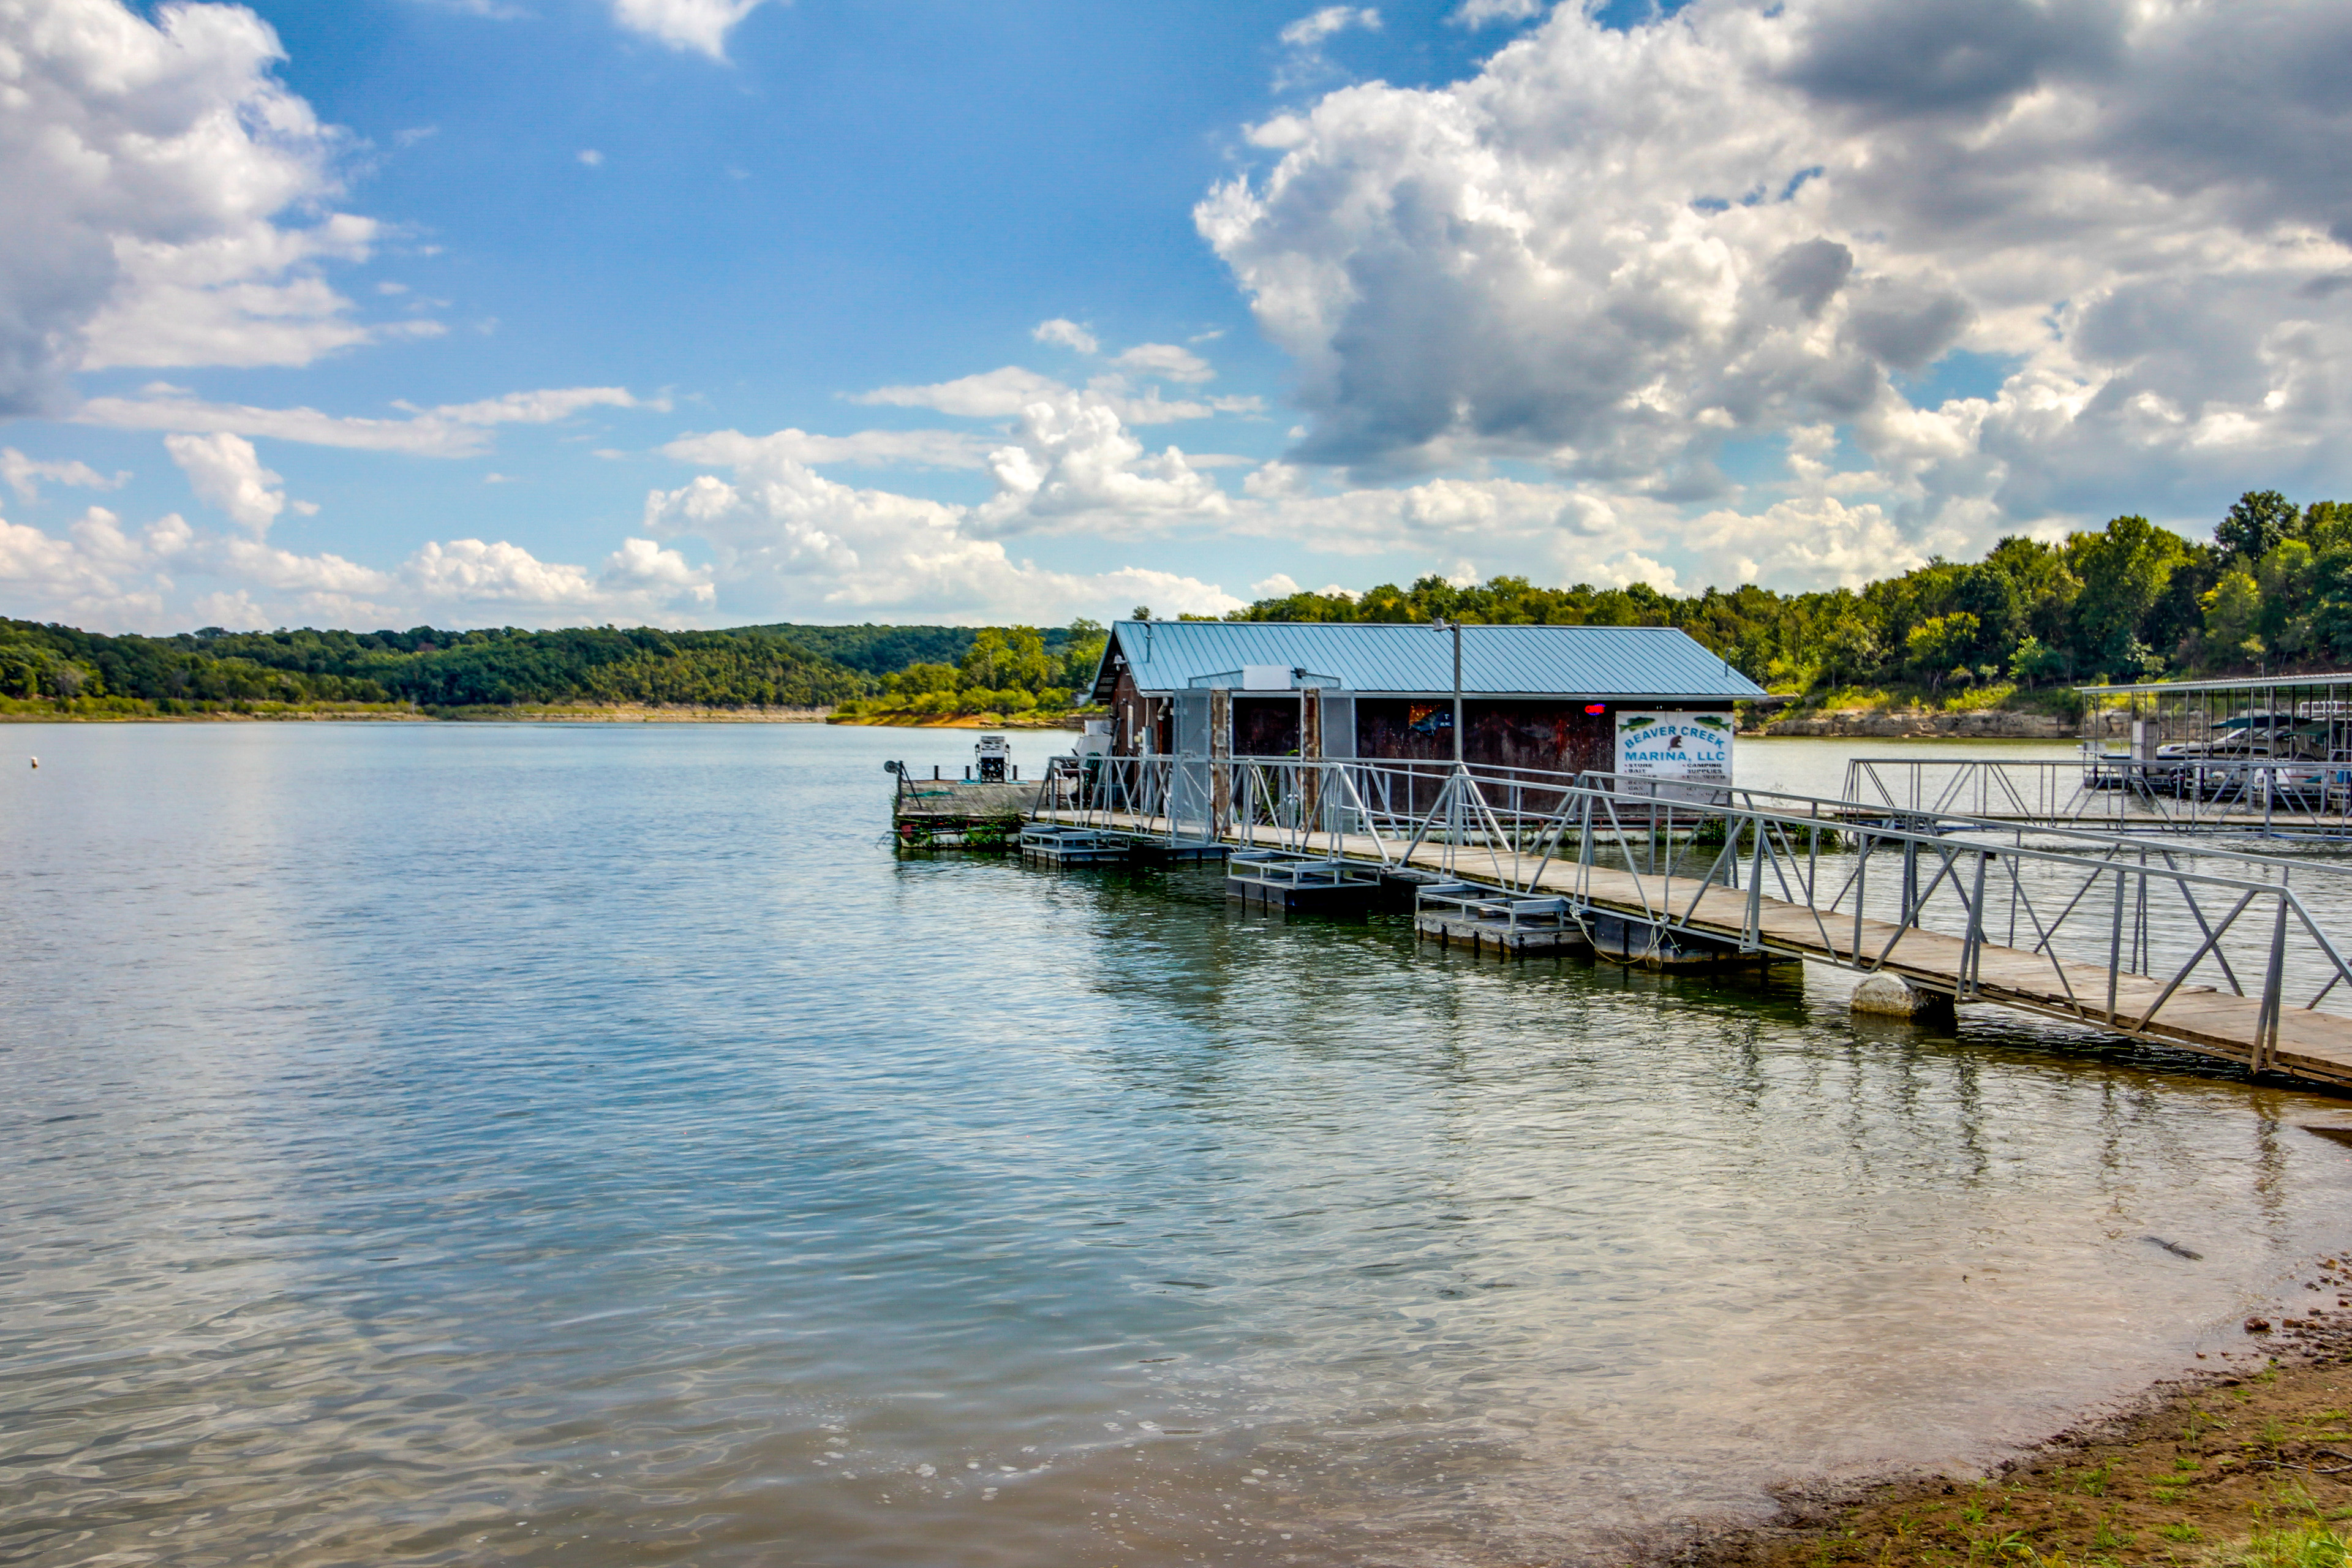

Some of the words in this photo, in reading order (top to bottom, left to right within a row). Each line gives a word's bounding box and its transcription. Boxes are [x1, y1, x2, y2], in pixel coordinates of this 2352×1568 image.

[1624, 726, 1676, 749] BEAVER
[1681, 726, 1725, 748] CREEK
[1624, 752, 1692, 761] MARINA,
[1698, 752, 1725, 761] LLC
